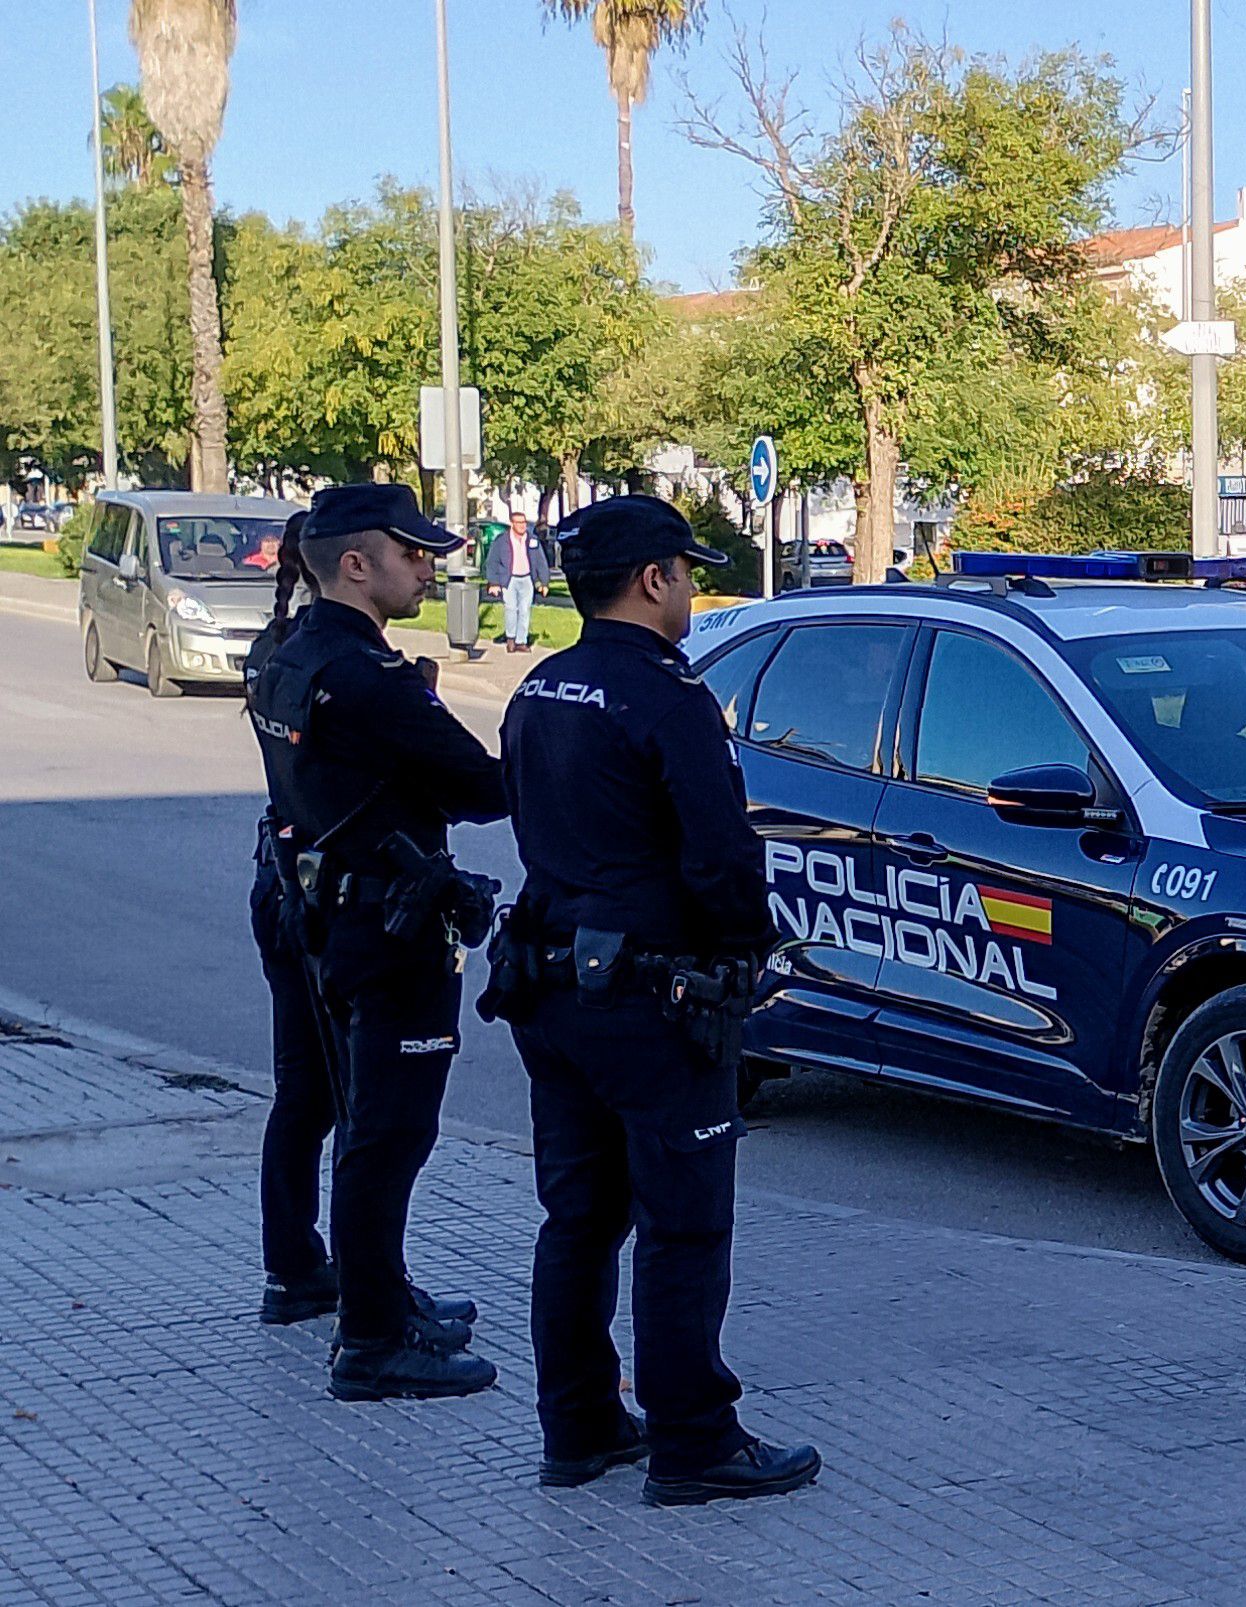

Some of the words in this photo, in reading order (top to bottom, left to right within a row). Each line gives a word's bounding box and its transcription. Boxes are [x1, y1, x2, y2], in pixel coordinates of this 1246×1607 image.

[696, 606, 751, 632] 5MT
[1166, 865, 1217, 901] 091
[767, 891, 1058, 1000] NACIONAL
